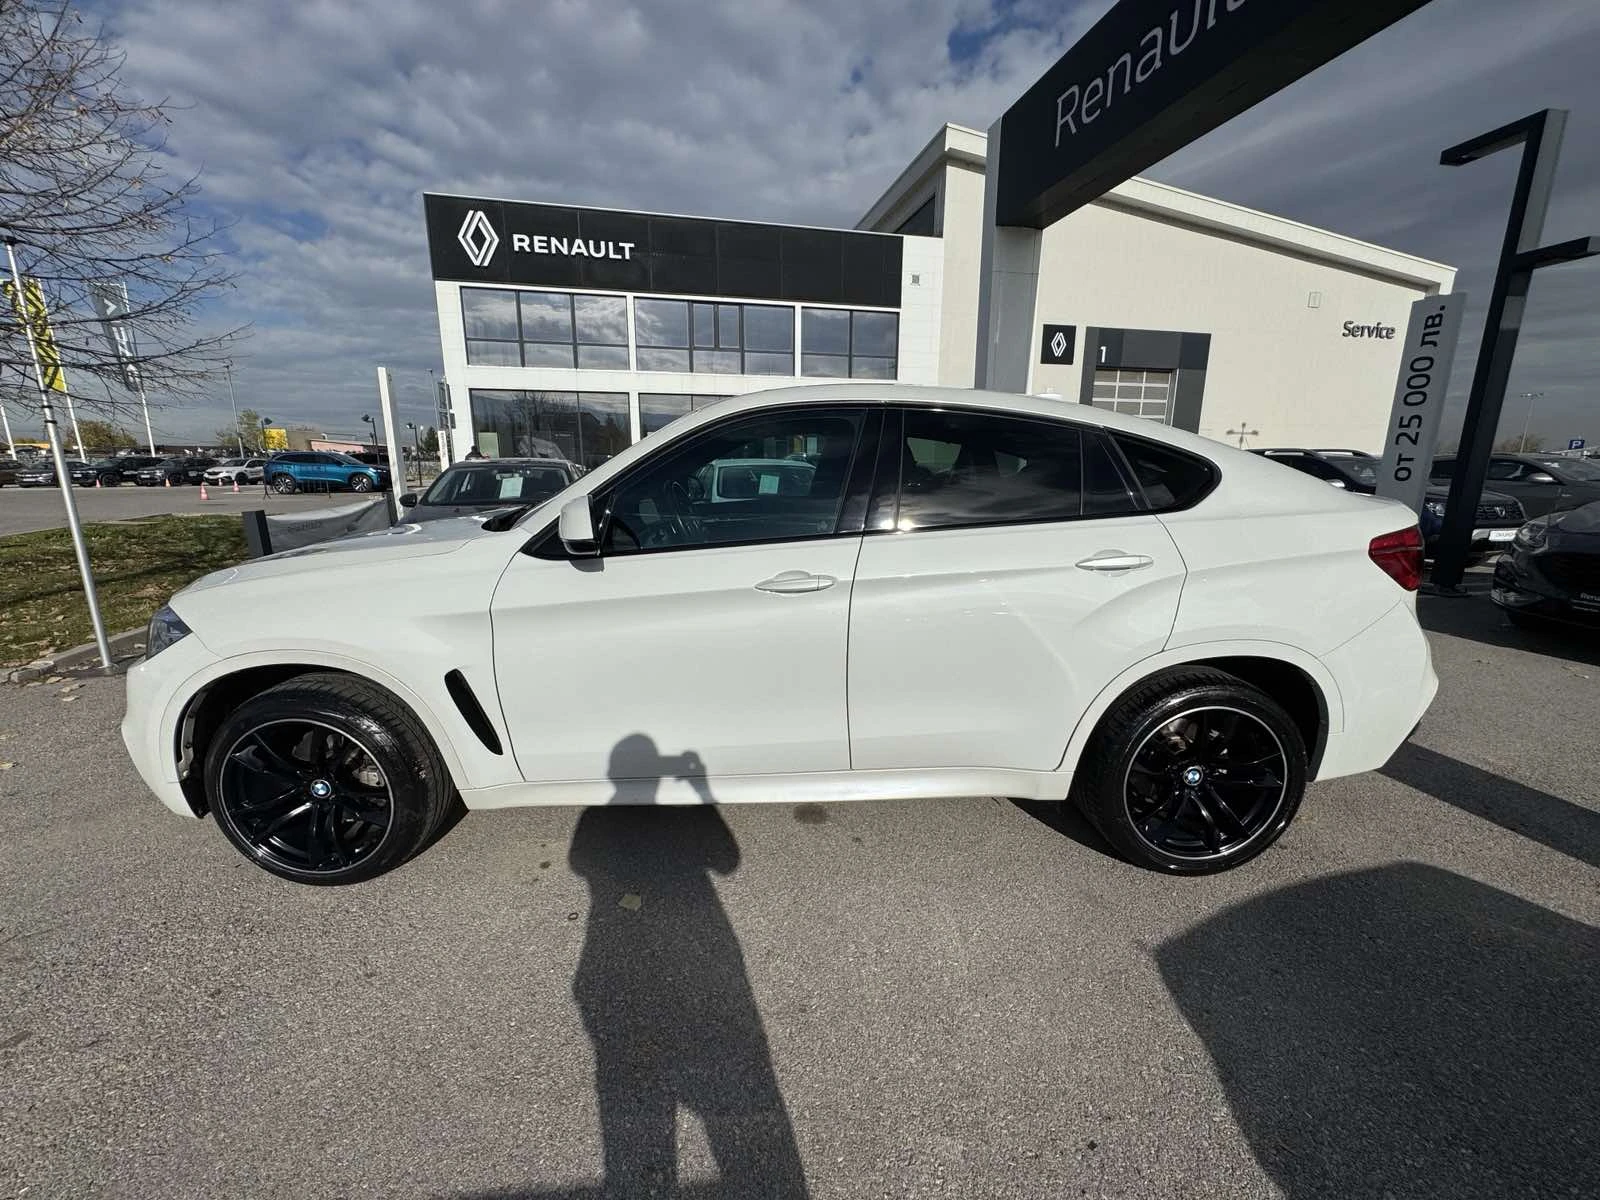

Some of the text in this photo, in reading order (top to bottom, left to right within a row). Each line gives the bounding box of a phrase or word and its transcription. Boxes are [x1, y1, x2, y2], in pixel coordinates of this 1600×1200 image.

[1055, 0, 1246, 148] Renau
[512, 233, 635, 260] RENAULT
[1342, 320, 1396, 339] Service
[1100, 345, 1107, 363] 1
[1403, 355, 1435, 407] 000
[1395, 414, 1423, 446] 25
[1571, 440, 1582, 449] P
